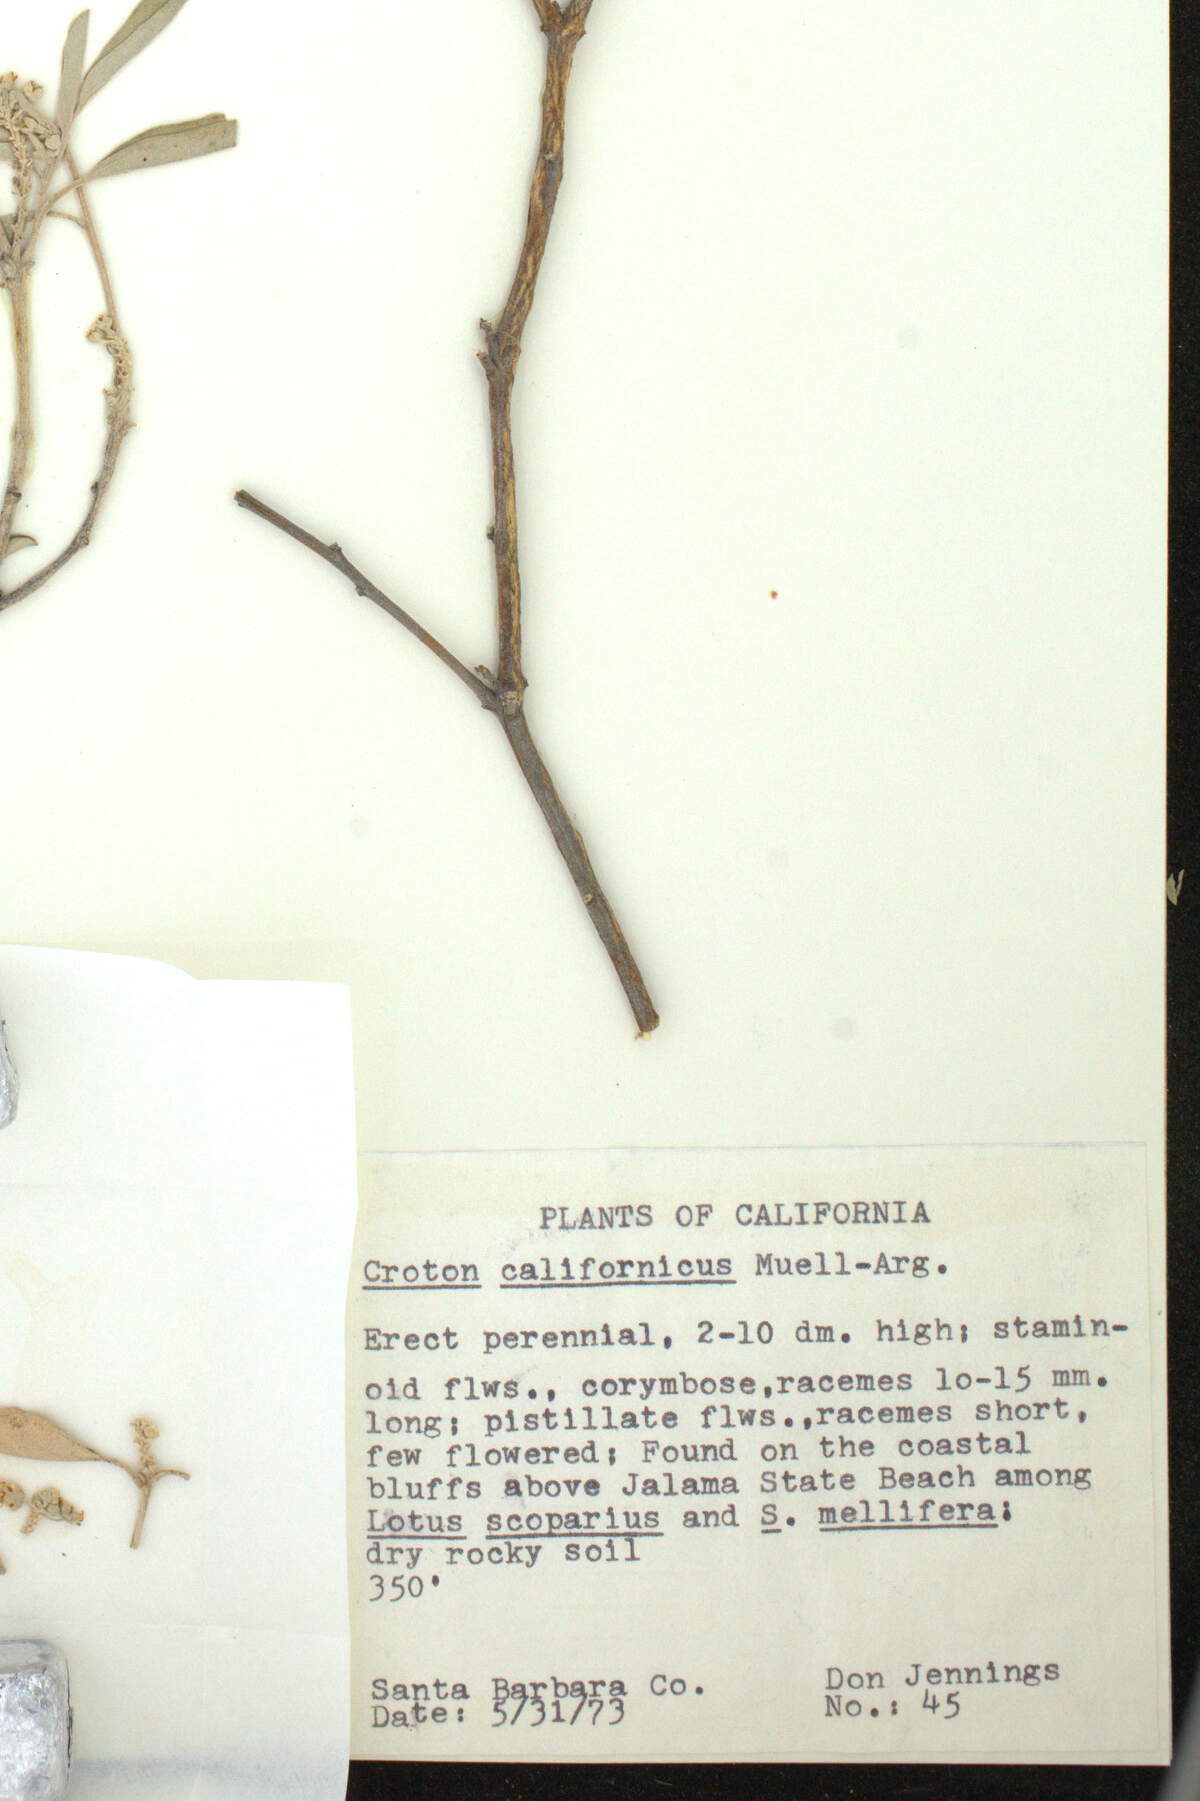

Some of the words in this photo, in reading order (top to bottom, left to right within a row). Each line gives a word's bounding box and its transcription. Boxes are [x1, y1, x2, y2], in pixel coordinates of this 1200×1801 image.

[539, 1204, 653, 1230] PLANTS
[675, 1204, 714, 1228] OF
[735, 1201, 931, 1227] CALIFORNIA
[362, 1259, 480, 1284] Croton
[501, 1255, 733, 1282] californicus
[755, 1252, 948, 1277] Muell-Arg.
[364, 1326, 459, 1351] Erect
[483, 1322, 672, 1354] perennial,
[697, 1320, 774, 1345] 2-10
[795, 1320, 851, 1344] dm.
[876, 1318, 969, 1345] high;
[993, 1314, 1128, 1339] stamin-
[365, 1377, 421, 1400] oid
[445, 1376, 556, 1401] flws.,
[1052, 1368, 1107, 1388] mm.
[366, 1410, 459, 1438] long;
[484, 1406, 678, 1437] pistillate
[975, 1398, 1087, 1424] short,
[366, 1444, 422, 1468] few
[446, 1440, 616, 1468] flowered;
[641, 1438, 738, 1464] Found
[760, 1442, 799, 1462] on
[820, 1435, 875, 1458] the
[898, 1430, 1032, 1457] coastal
[367, 1477, 482, 1500] bluffs
[504, 1474, 601, 1497] above
[622, 1473, 739, 1497] Jalama
[760, 1469, 856, 1493] State
[878, 1465, 976, 1489] Beach
[994, 1467, 1092, 1490] among
[367, 1509, 463, 1533] Lotus
[486, 1505, 660, 1534] scoparius
[682, 1504, 739, 1528] and
[761, 1504, 796, 1527] S.
[819, 1500, 1012, 1524] mellifera;
[366, 1542, 423, 1569] dry
[445, 1541, 543, 1567] rocky
[564, 1538, 641, 1562] soil
[371, 1678, 470, 1701] Santa
[491, 1675, 628, 1701] Barbara
[650, 1674, 704, 1696] Co.
[825, 1667, 885, 1691] Don
[905, 1661, 1060, 1687] Jennings
[371, 1700, 466, 1729] Date:
[491, 1698, 626, 1728] 5/31/73
[825, 1695, 899, 1718] No.:
[922, 1689, 961, 1719] 45
